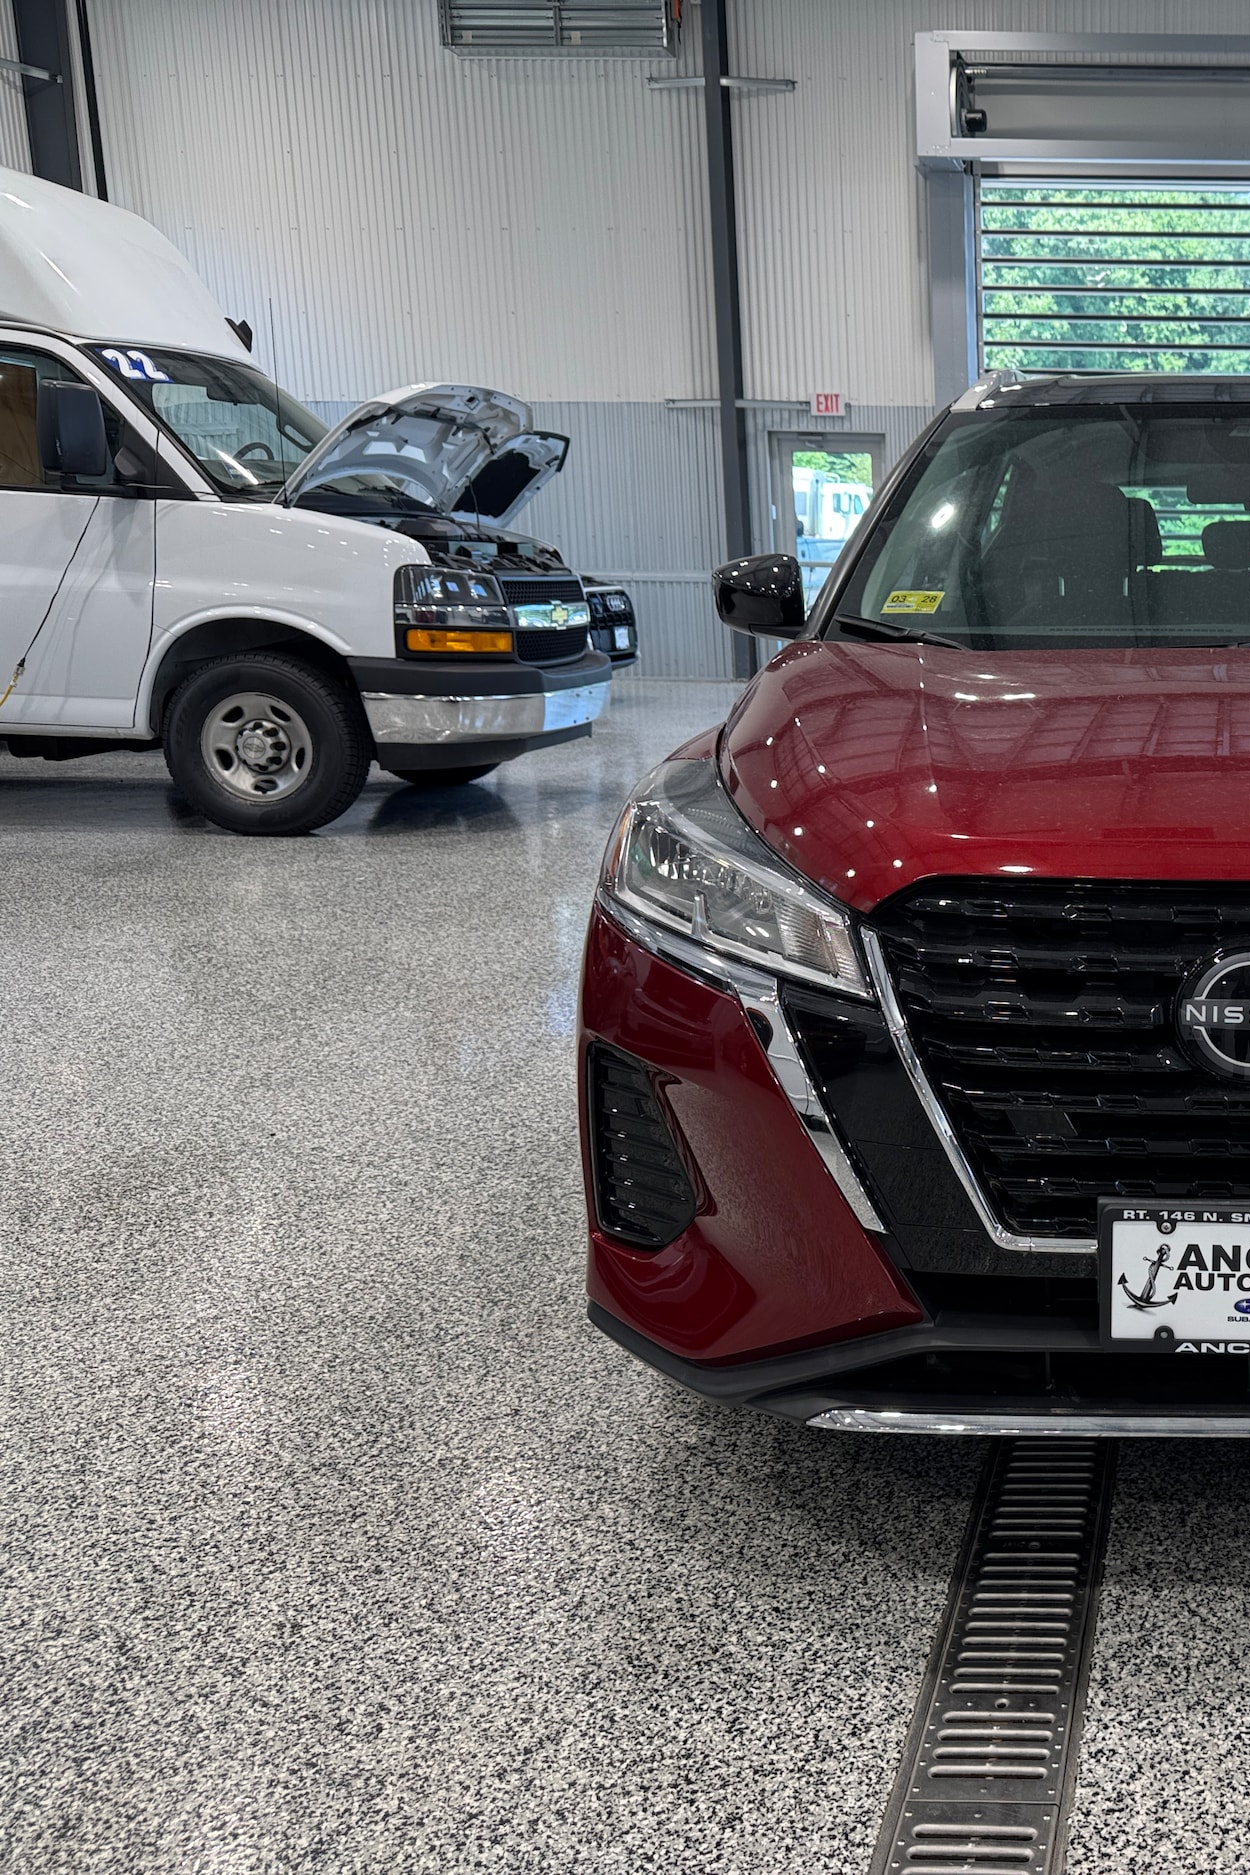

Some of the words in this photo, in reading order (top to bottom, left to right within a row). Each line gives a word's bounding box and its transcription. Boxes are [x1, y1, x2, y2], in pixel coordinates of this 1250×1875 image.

[101, 349, 170, 381] 22
[816, 393, 840, 413] EXIT
[1123, 1210, 1150, 1221] RT.
[1158, 1210, 1196, 1222] 146
[1202, 1211, 1223, 1223] N.
